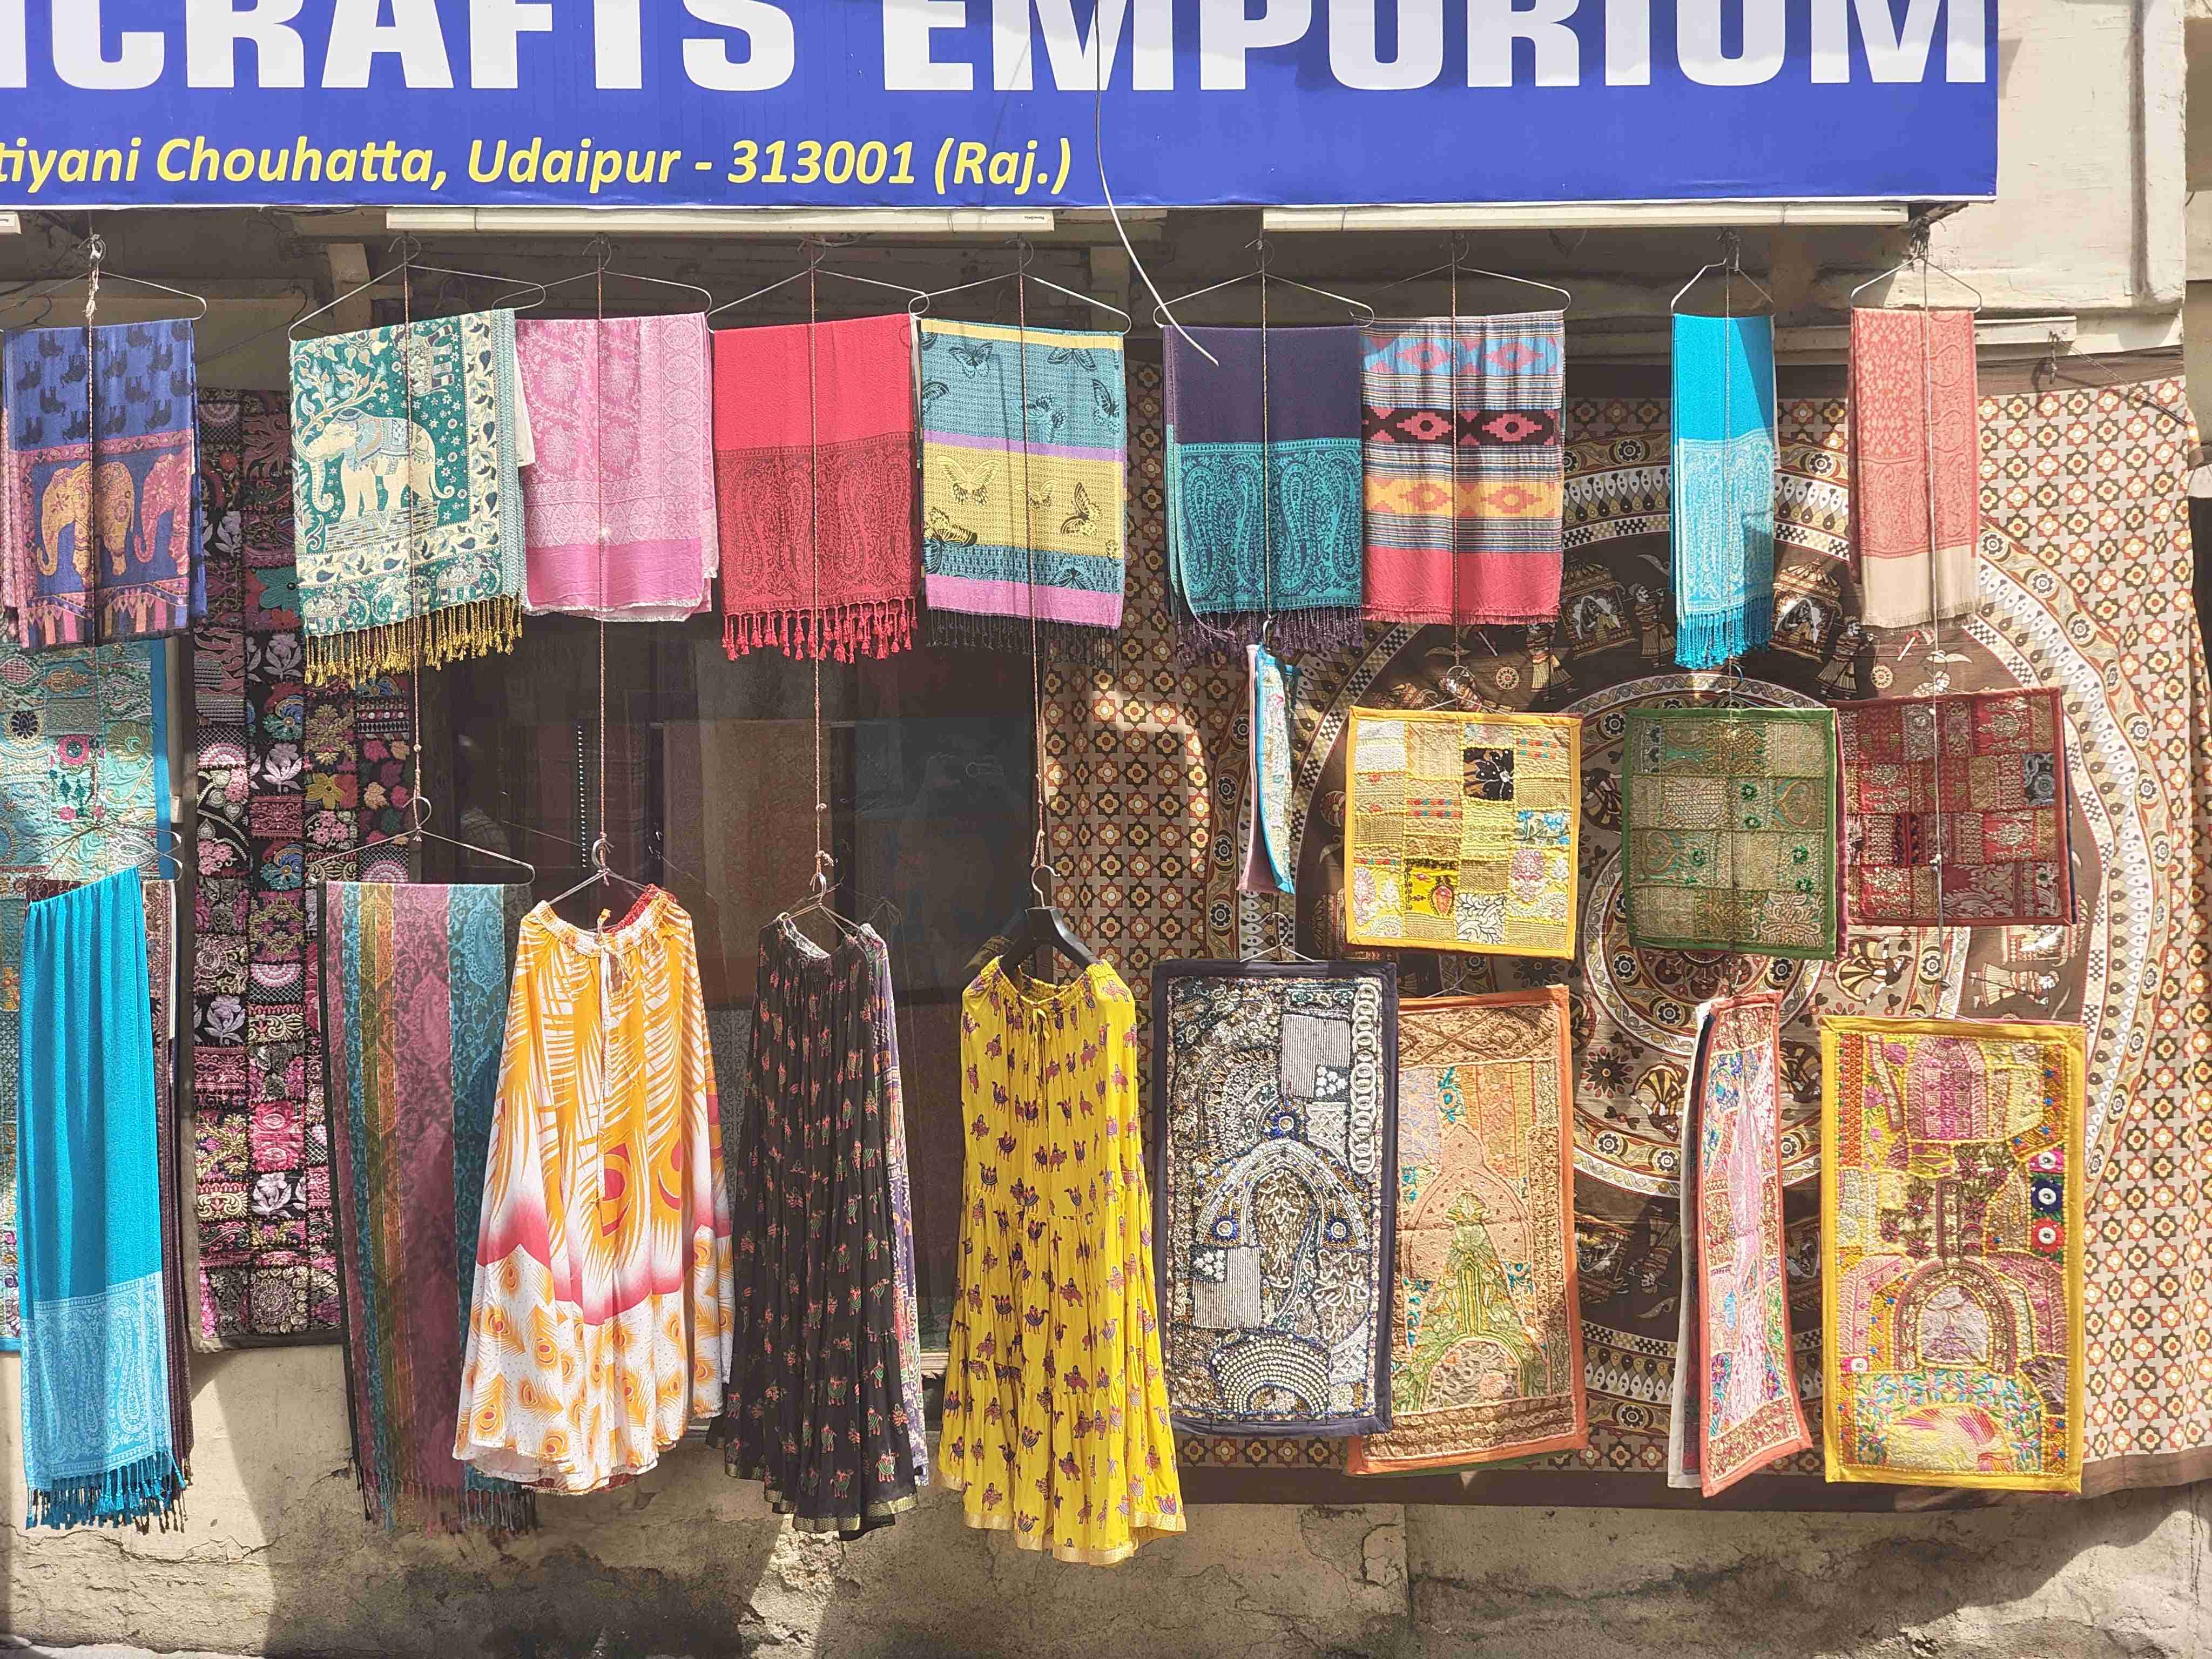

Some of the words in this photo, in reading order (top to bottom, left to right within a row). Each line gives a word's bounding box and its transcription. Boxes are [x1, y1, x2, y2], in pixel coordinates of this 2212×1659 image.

[882, 0, 1987, 91] EMPORIUM
[157, 136, 446, 191] Chouhatta,
[469, 137, 682, 193] Udaipur
[696, 162, 712, 171] -
[727, 140, 914, 184] 313001
[935, 138, 1070, 195] (Raj.)
